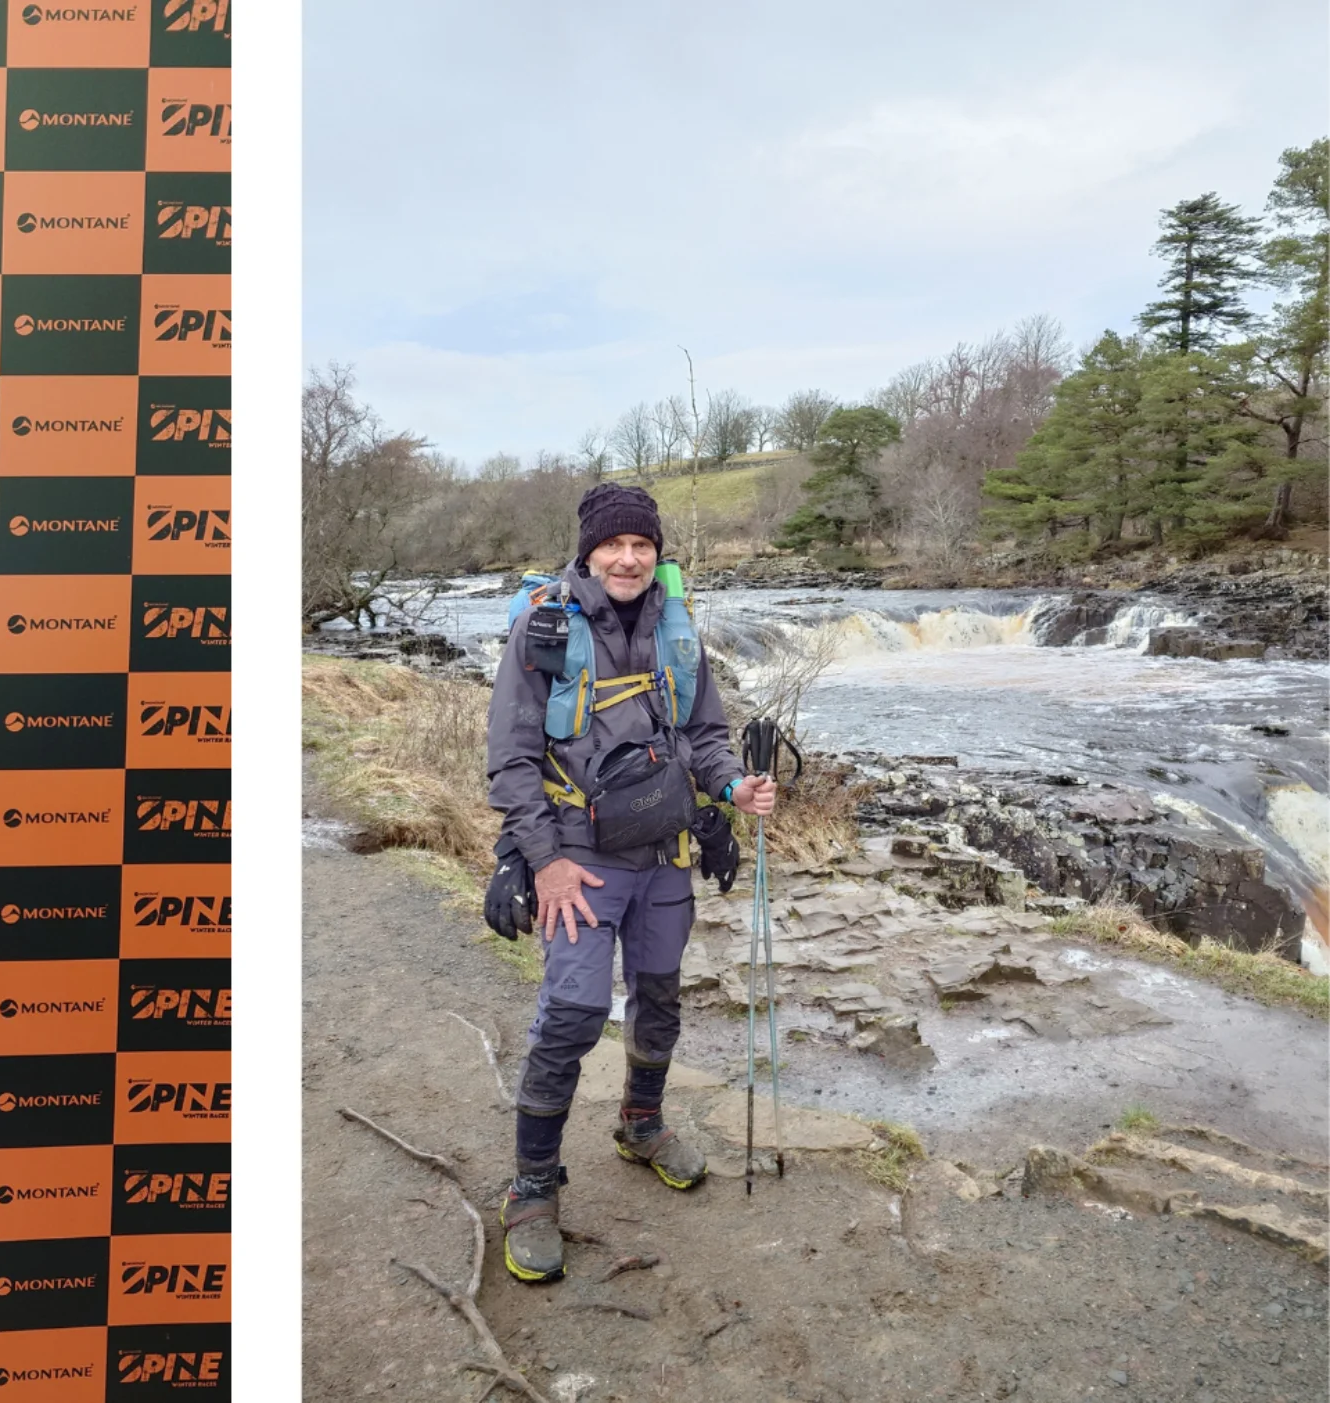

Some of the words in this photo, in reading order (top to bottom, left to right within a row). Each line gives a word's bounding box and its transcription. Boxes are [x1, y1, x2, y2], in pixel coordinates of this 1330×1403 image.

[45, 9, 136, 22] MONTANE
[42, 113, 131, 126] MONTANE
[40, 217, 128, 229] MONTANE
[37, 319, 125, 331] MONTANE
[35, 420, 123, 432] MONTANE
[32, 519, 119, 532] MONTANE
[29, 618, 116, 630] MONTANE
[143, 607, 231, 638] SPIN
[27, 715, 113, 728] MONTANE
[141, 705, 231, 736] SPIN
[25, 811, 109, 824] MONTANE
[23, 906, 106, 919] MONTANE
[134, 896, 231, 926] SPINE
[21, 1001, 103, 1014] MONTANE
[130, 989, 231, 1019] SPINE
[18, 1093, 100, 1107] MONTANE
[127, 1082, 231, 1113] SPINE
[16, 1185, 98, 1200] MONTANE
[124, 1173, 231, 1204] SPINE
[14, 1276, 95, 1291] MONTANE
[121, 1264, 227, 1295] SPINE
[12, 1366, 92, 1381] MONTANE
[118, 1351, 223, 1383] SPINE
